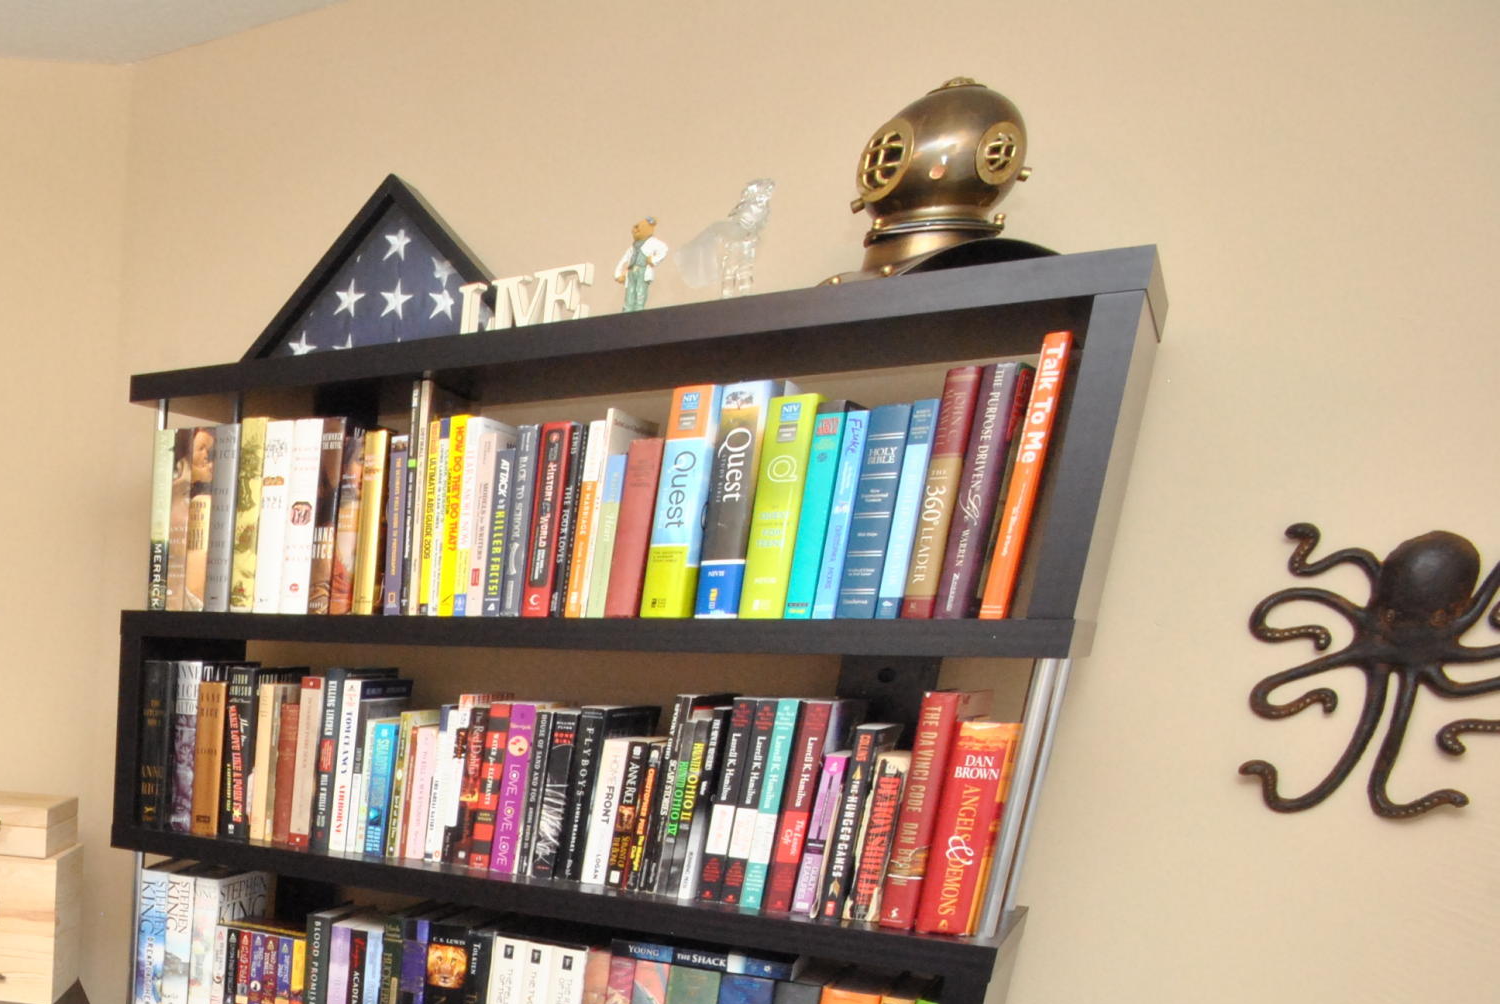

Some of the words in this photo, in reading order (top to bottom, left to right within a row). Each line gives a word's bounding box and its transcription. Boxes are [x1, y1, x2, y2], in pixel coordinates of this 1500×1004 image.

[457, 262, 596, 336] LIVE
[993, 368, 1005, 388] THE
[1036, 341, 1066, 392] Talk
[783, 404, 801, 413] NIV
[980, 391, 1001, 442] PURPOSE
[1031, 396, 1054, 425] To
[454, 425, 465, 453] HOW
[570, 431, 580, 455] LEWIS
[869, 446, 898, 456] HOLY
[1021, 430, 1046, 464] Me
[452, 455, 463, 473] DO
[517, 455, 529, 482] BACK
[717, 427, 753, 503] Quest
[867, 456, 896, 465] BIBLE
[931, 469, 948, 477] THE
[970, 444, 990, 491] DRIVEN
[427, 457, 437, 496] ULTIMATE
[451, 474, 461, 502] THEY
[497, 458, 510, 498] ATTACK
[665, 451, 697, 529] Quest
[425, 497, 435, 513] ABS
[515, 484, 525, 501] TO
[563, 486, 573, 506] THE
[449, 502, 460, 519] DO
[579, 493, 591, 536] MARRIAGE
[960, 487, 982, 527] Life
[424, 514, 434, 537] GUIDE
[491, 510, 505, 555] KILLER
[511, 502, 524, 541] SCHOOL
[447, 522, 459, 552] THAT?
[556, 535, 567, 564] LOVES
[954, 528, 971, 568] WARREN
[912, 527, 937, 585] LEADER
[151, 543, 165, 608] MERRICK
[487, 556, 501, 597] FACTS!
[326, 680, 338, 708] KILLING
[228, 704, 239, 729] MAKE
[323, 709, 335, 737] LINCOLN
[343, 711, 353, 734] TOM
[475, 711, 484, 723] The
[538, 714, 548, 737] HOUSE
[668, 702, 680, 736] SPOOKY
[922, 704, 942, 727] THE
[230, 729, 241, 751] LOVE
[470, 724, 485, 743] Red
[489, 733, 500, 754] WATER
[536, 739, 545, 750] OF
[728, 732, 742, 759] Laurell
[920, 730, 938, 747] DA
[232, 752, 243, 771] LIKE
[340, 734, 352, 776] CLANCY
[467, 743, 482, 777] Dahlia
[533, 751, 543, 771] SAND
[664, 737, 674, 760] OHIO
[753, 735, 767, 762] Laurell
[772, 734, 787, 762] Laurell
[802, 736, 818, 763] Laurell
[857, 733, 871, 763] COLLINS
[964, 753, 995, 768] DAN
[665, 759, 677, 786] SCARY
[912, 748, 935, 782] VINCI
[954, 764, 1000, 781] BROWN
[483, 767, 495, 806] ELEPHANTS
[504, 763, 520, 797] LOVE,
[531, 772, 540, 787] AND
[640, 767, 655, 817] CHRISTOPHER
[683, 773, 700, 810] OHIO
[720, 770, 735, 803] Hamilton
[745, 772, 760, 805] Hamilton
[763, 773, 779, 810] Hamilton
[794, 773, 810, 808] Hamilton
[850, 779, 860, 794] THE
[529, 788, 538, 803] FOG
[660, 785, 673, 817] STORIES
[670, 789, 685, 821] OHIO
[905, 784, 926, 813] CODE
[680, 811, 692, 822] II
[839, 794, 858, 841] HUNGER
[958, 783, 982, 842] ANGELS
[667, 823, 678, 837] IV
[896, 821, 918, 844] DAN
[496, 835, 511, 866] LOVE
[831, 842, 850, 879] GAMES
[592, 853, 603, 880] LOGAN
[219, 876, 268, 902] STEPHEN
[937, 856, 966, 917] DEMONS
[140, 881, 155, 935] KING
[154, 880, 168, 937] STEPHEN
[166, 879, 180, 931] KING
[178, 880, 191, 935] STEPHEN
[311, 920, 323, 957] BLOOD
[628, 944, 660, 958] YOUNG
[692, 953, 727, 968] SHACK
